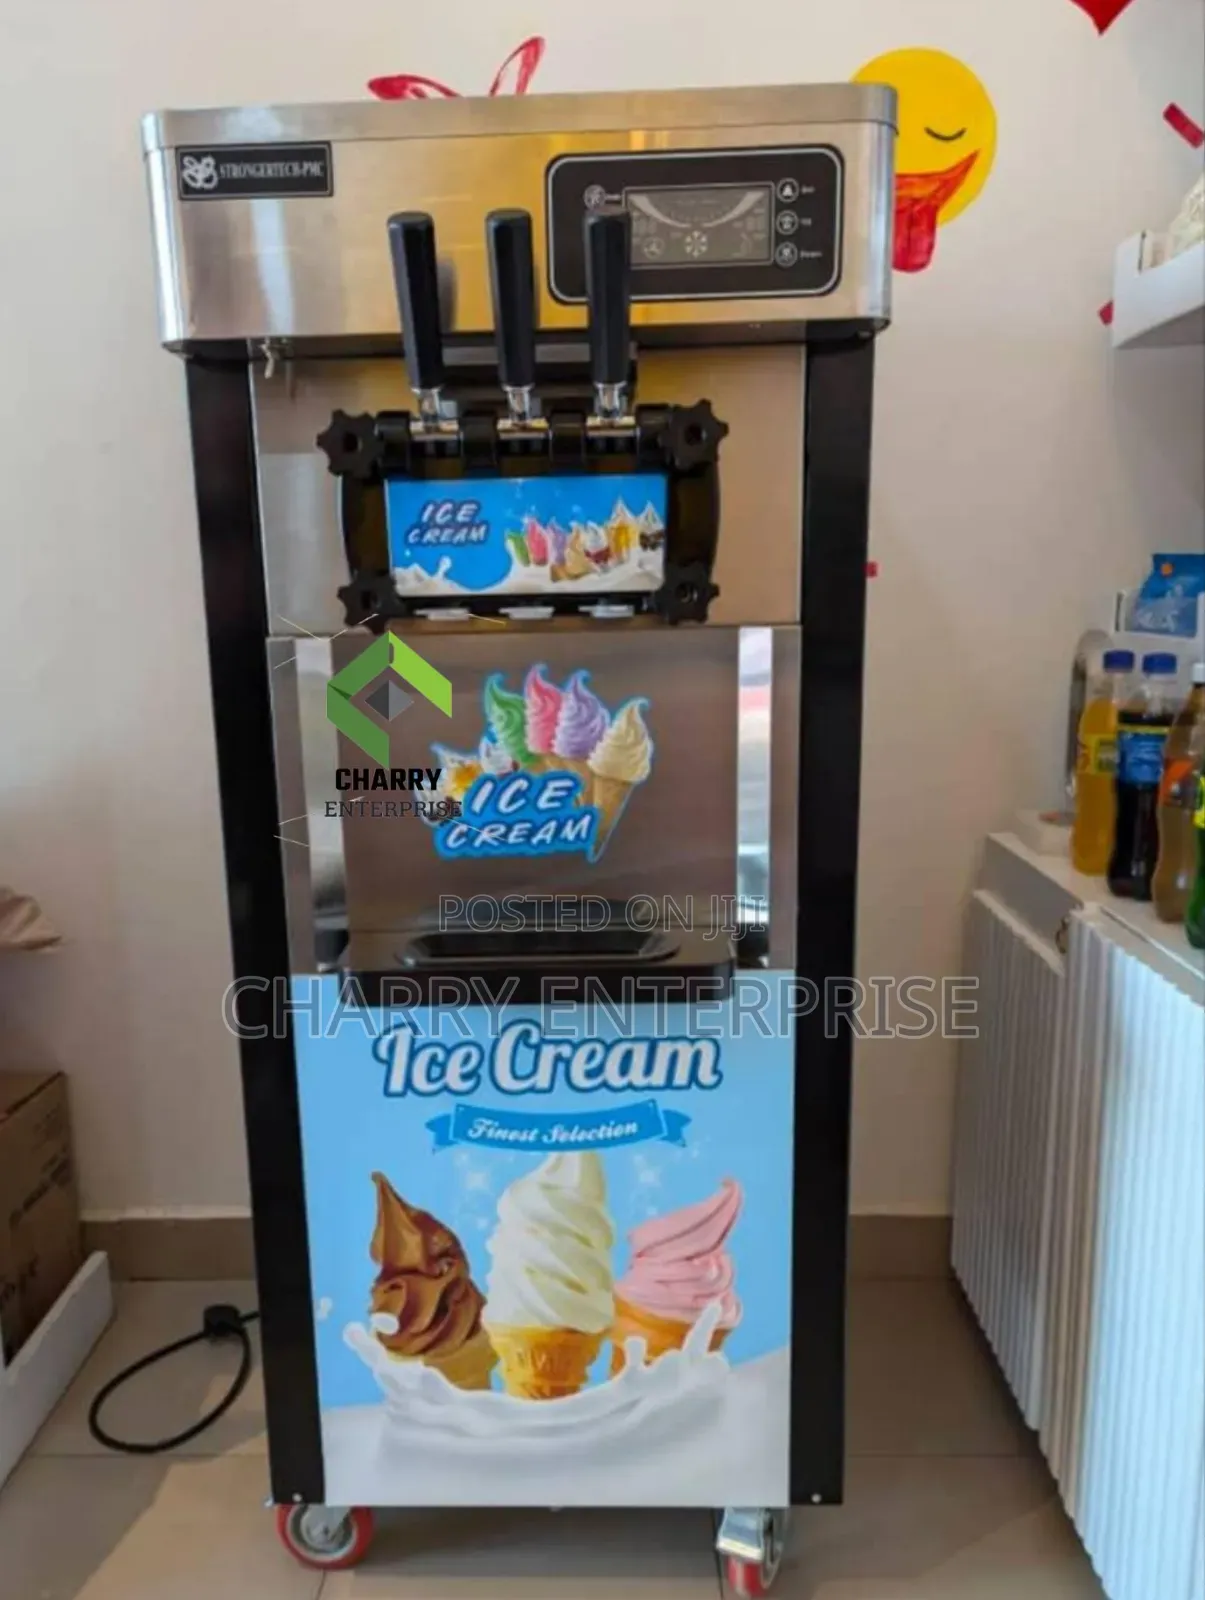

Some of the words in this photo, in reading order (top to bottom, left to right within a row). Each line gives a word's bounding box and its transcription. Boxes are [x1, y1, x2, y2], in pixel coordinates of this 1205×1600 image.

[421, 502, 478, 523] ICE
[407, 524, 486, 545] CREAM
[472, 778, 575, 815] ICE
[446, 813, 592, 849] CREAM
[373, 1021, 484, 1098] Ice
[489, 1018, 723, 1096] Cream
[467, 1117, 537, 1143] Finest
[542, 1118, 640, 1144] Selection
